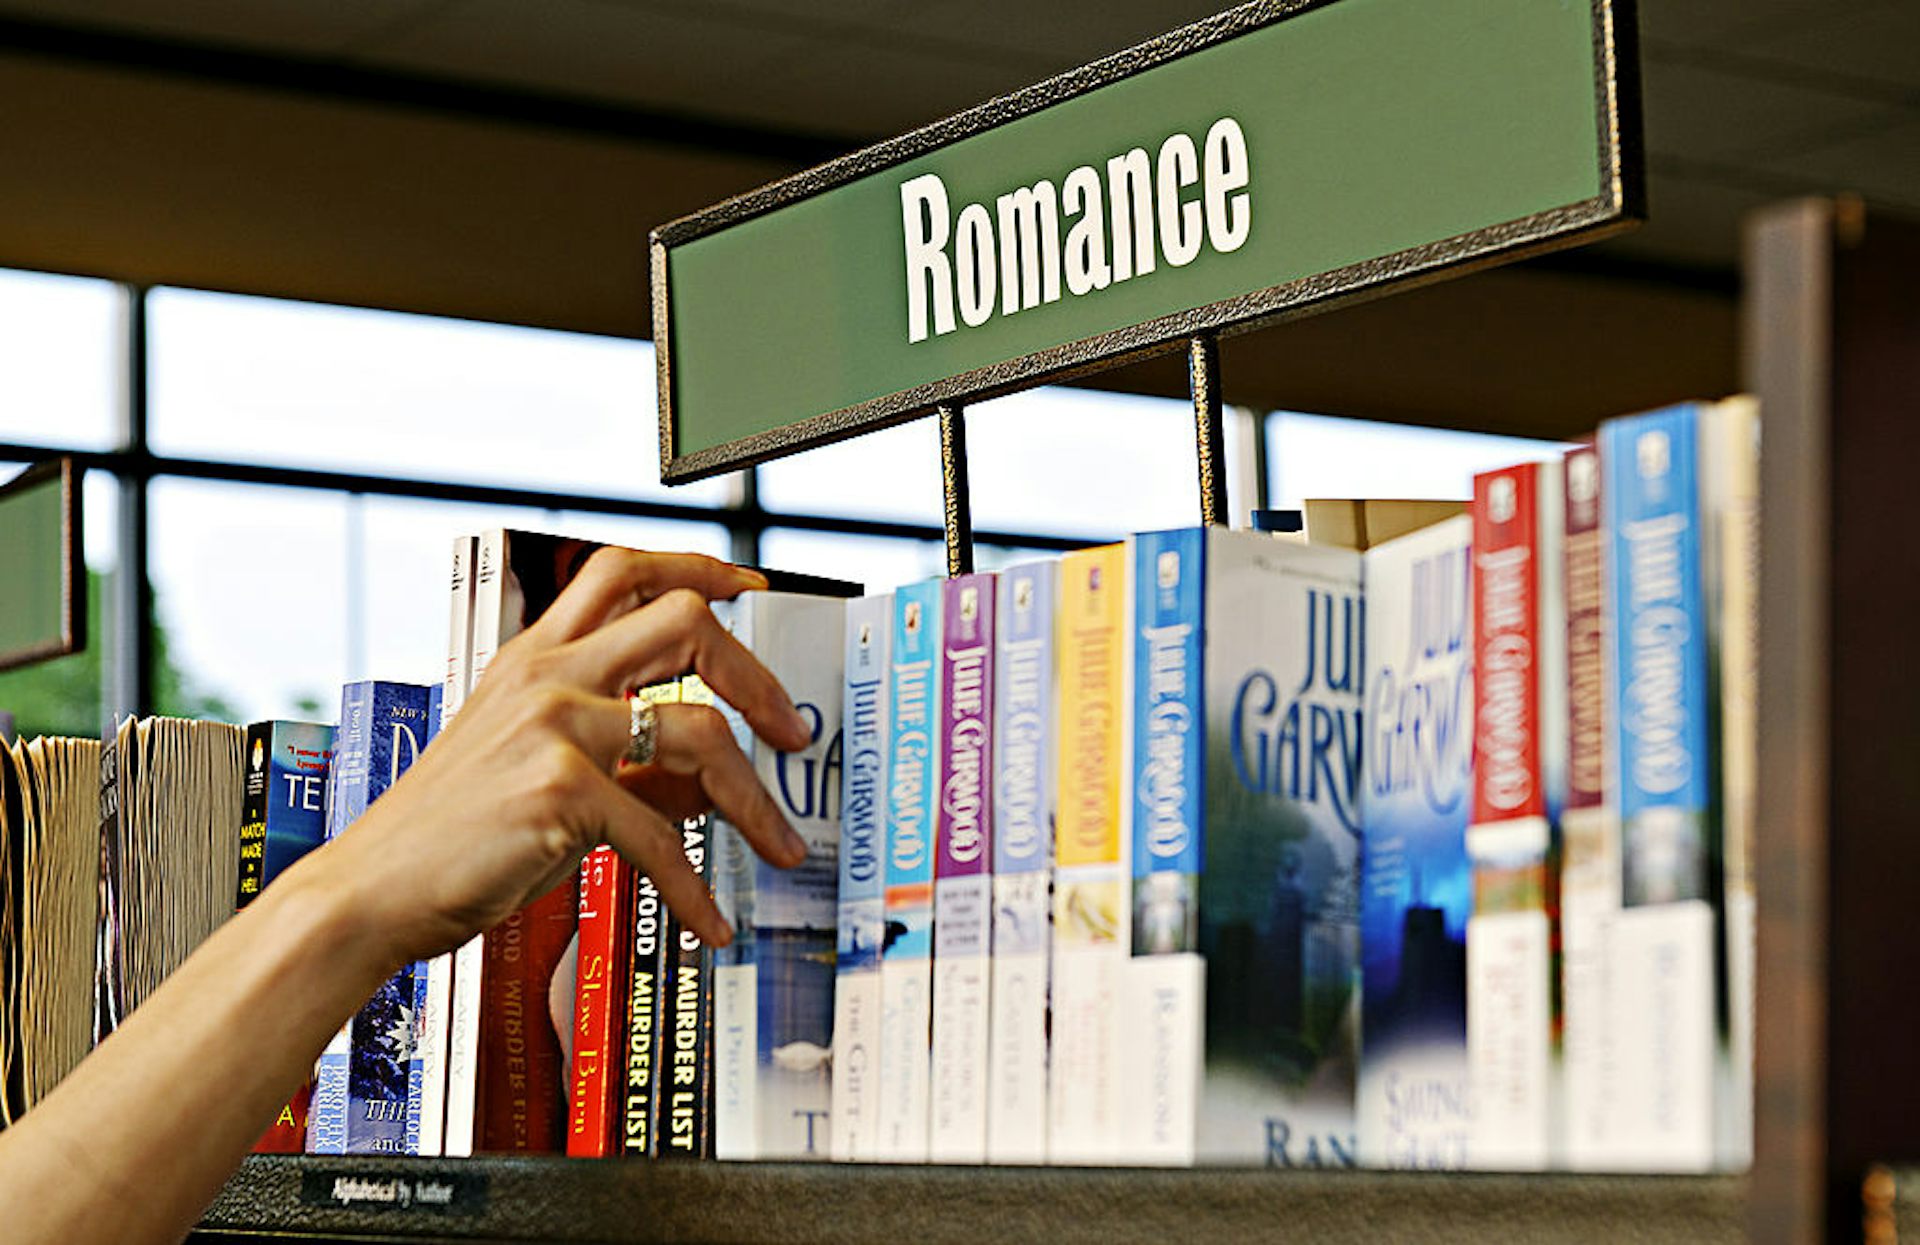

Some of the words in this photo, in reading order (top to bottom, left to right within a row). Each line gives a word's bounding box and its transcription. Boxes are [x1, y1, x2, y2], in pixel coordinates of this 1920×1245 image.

[900, 117, 1251, 345] Romance
[893, 659, 932, 730] JULIE
[945, 646, 988, 720] JULIE
[1142, 623, 1193, 702] JULIE
[849, 679, 881, 746] JULIE
[843, 750, 880, 882] GARWOOD
[889, 731, 928, 870] GARWOOD
[942, 719, 985, 862] GARWOOD
[1140, 702, 1192, 858] GARWOOD
[240, 822, 266, 839] MATCH
[241, 842, 262, 859] MADE
[580, 955, 602, 1036] Slow
[629, 972, 653, 1087] MURDER
[673, 966, 699, 1085] MURDER
[314, 1065, 332, 1149] GARLOCK
[329, 1065, 346, 1149] DOROTHY
[404, 1070, 423, 1156] GARLOCK
[574, 1050, 598, 1134] Burn
[625, 1095, 648, 1152] LIST
[671, 1092, 694, 1150] LIST
